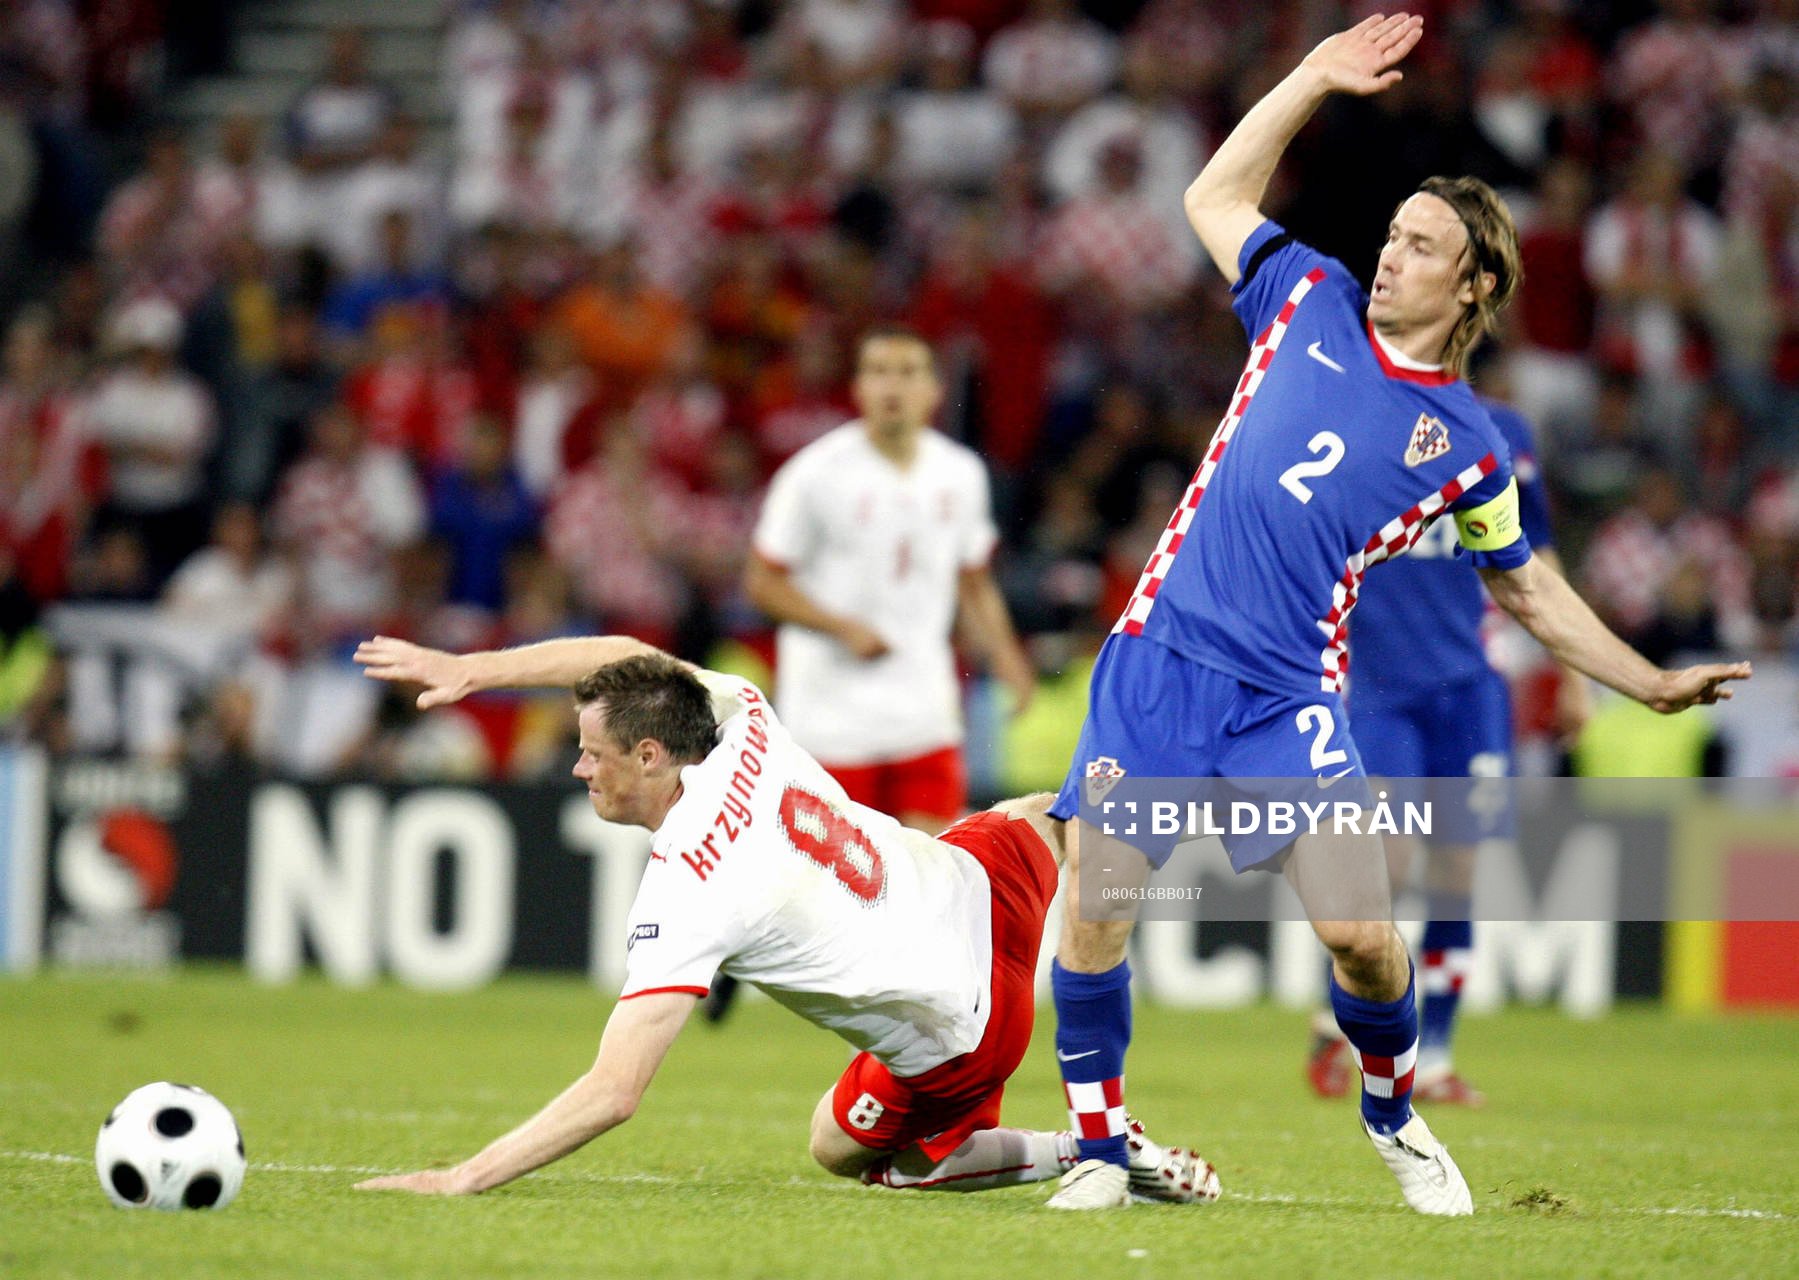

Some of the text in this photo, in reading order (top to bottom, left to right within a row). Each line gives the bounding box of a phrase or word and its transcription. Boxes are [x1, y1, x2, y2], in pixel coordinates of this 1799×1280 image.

[1278, 431, 1345, 505] 2
[1295, 704, 1347, 770] 2
[778, 782, 887, 907] 8
[248, 784, 516, 991] NO
[848, 1092, 885, 1130] 8
